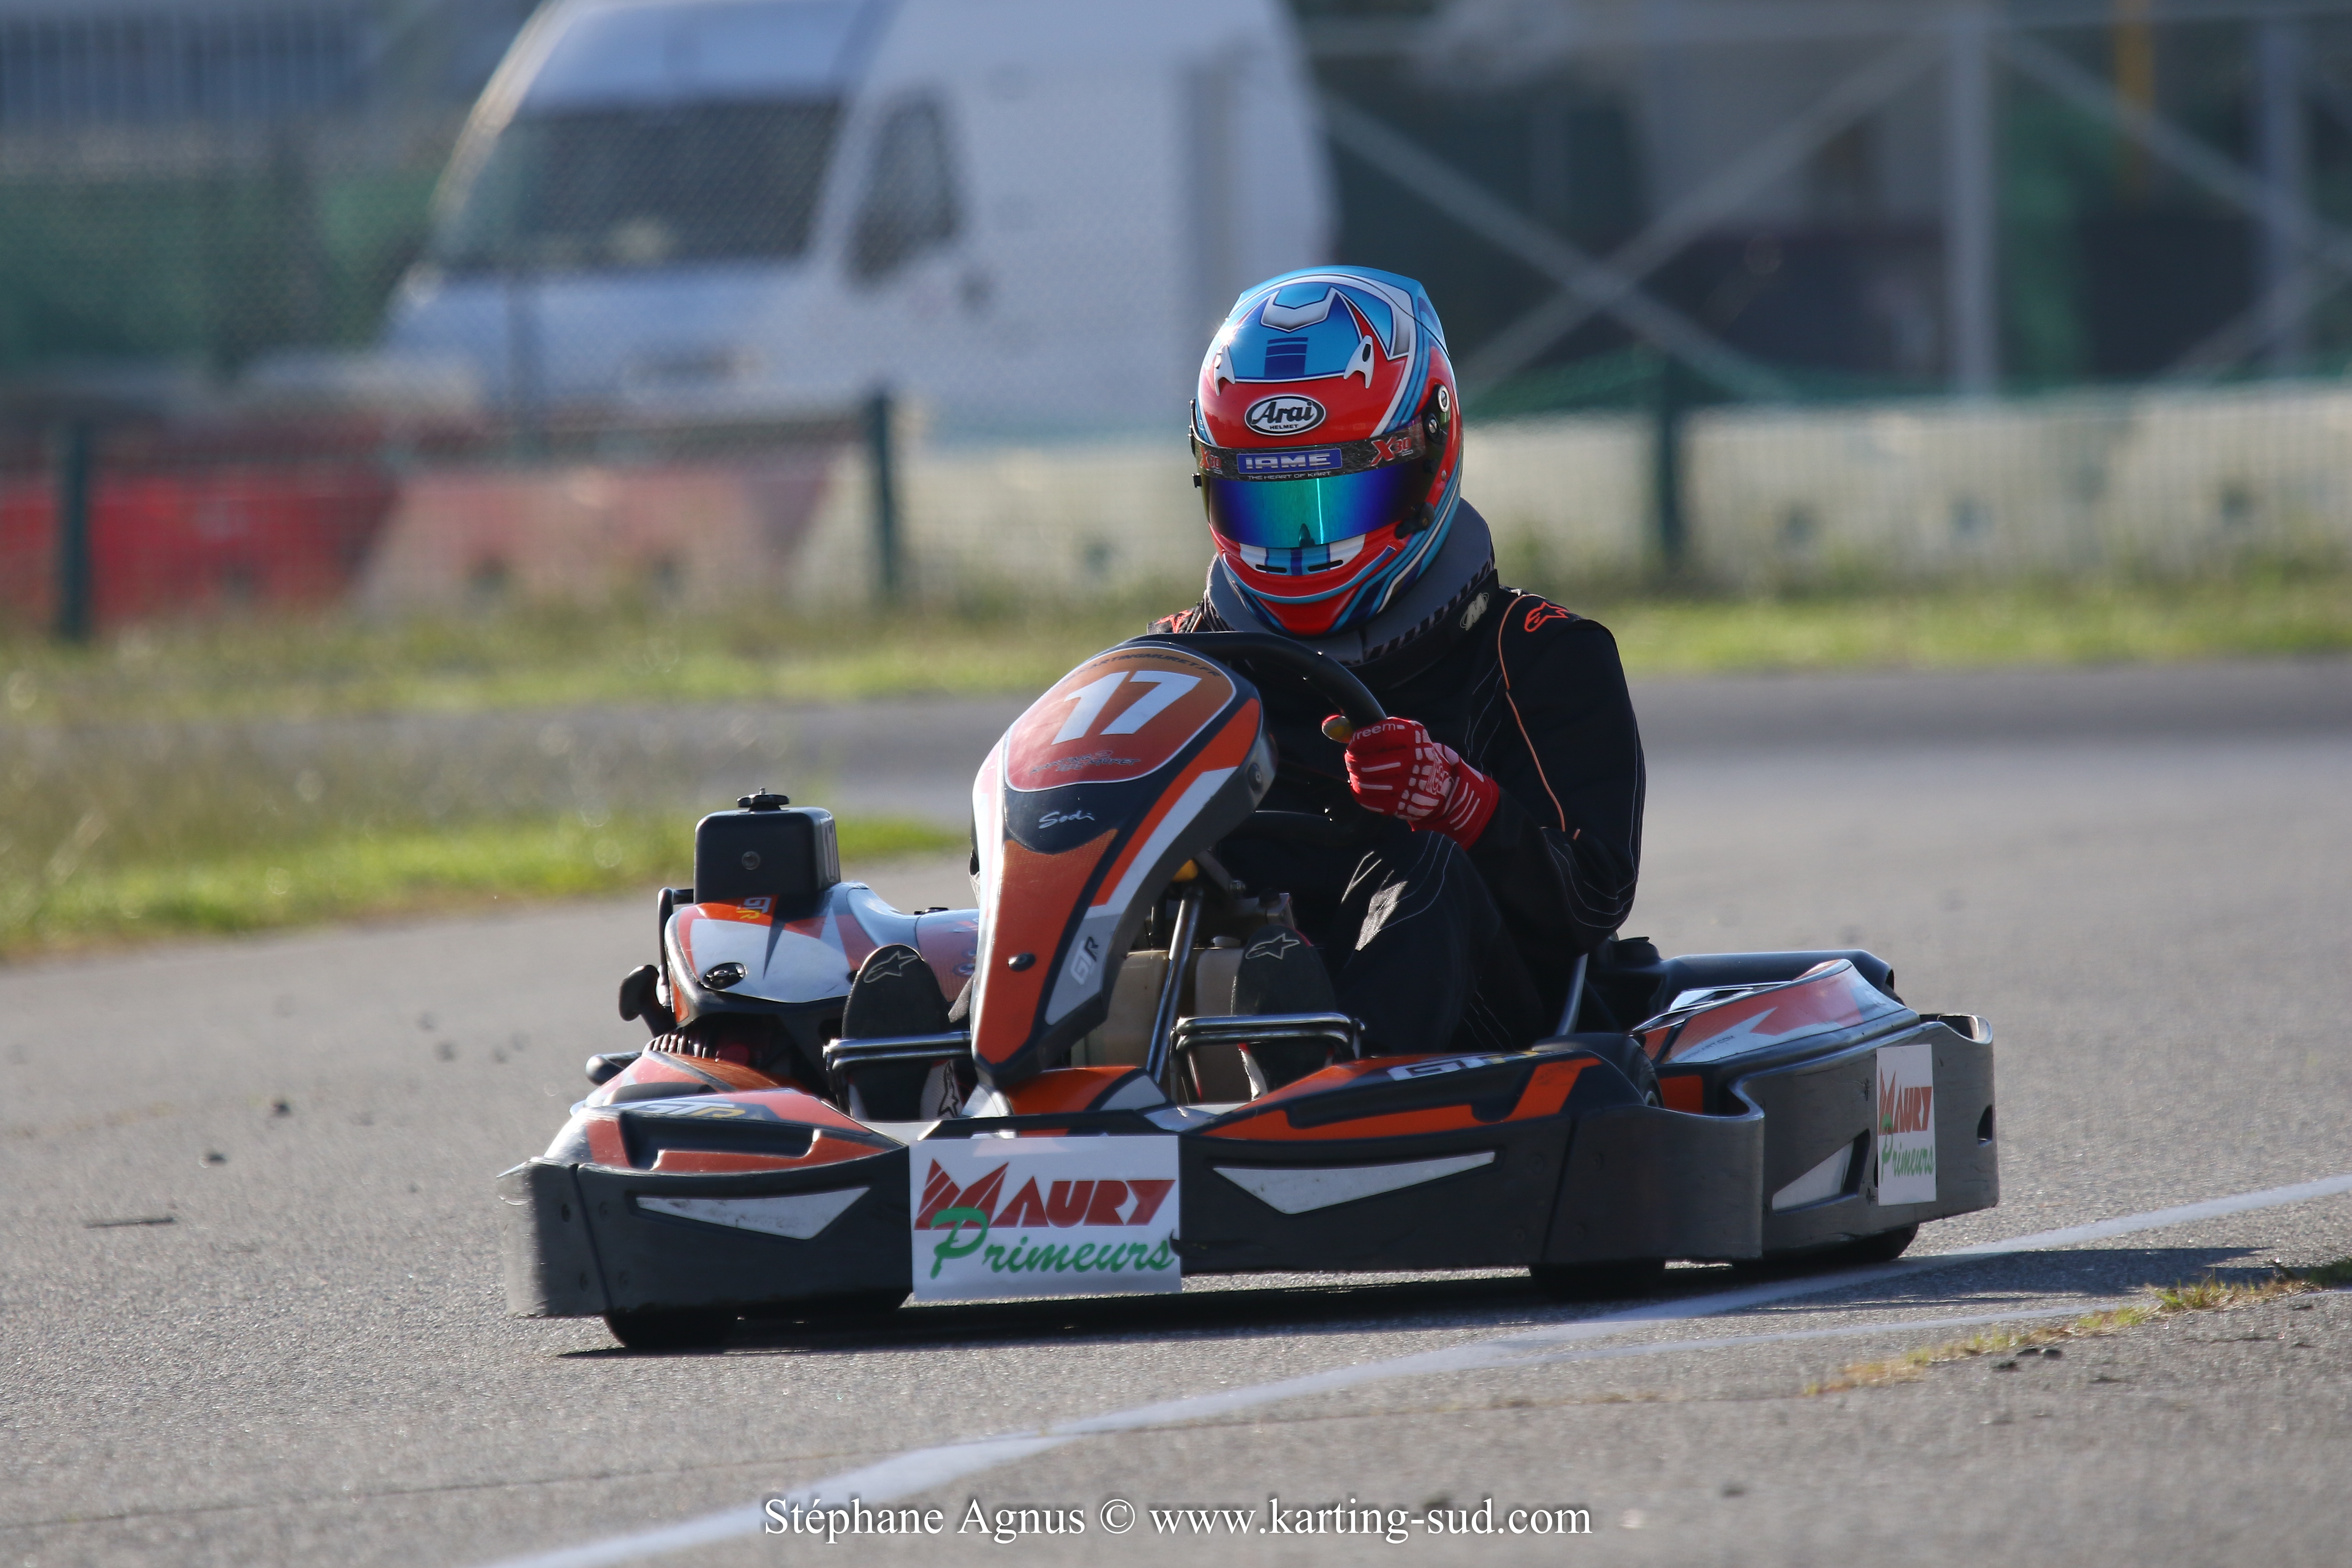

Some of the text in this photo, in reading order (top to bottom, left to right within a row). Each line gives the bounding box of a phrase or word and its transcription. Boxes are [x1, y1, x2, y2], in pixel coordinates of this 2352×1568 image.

[1250, 401, 1314, 426] Arai
[1199, 445, 1222, 471] X30
[1246, 453, 1331, 470] IAME
[1370, 436, 1412, 467] X30
[1050, 670, 1202, 746] 17
[1038, 810, 1096, 830] Sodi
[1878, 1066, 1932, 1136] MAURY
[1881, 1112, 1934, 1184] Primeurs
[914, 1158, 1176, 1231] MAURY
[929, 1207, 1176, 1280] Primeurs
